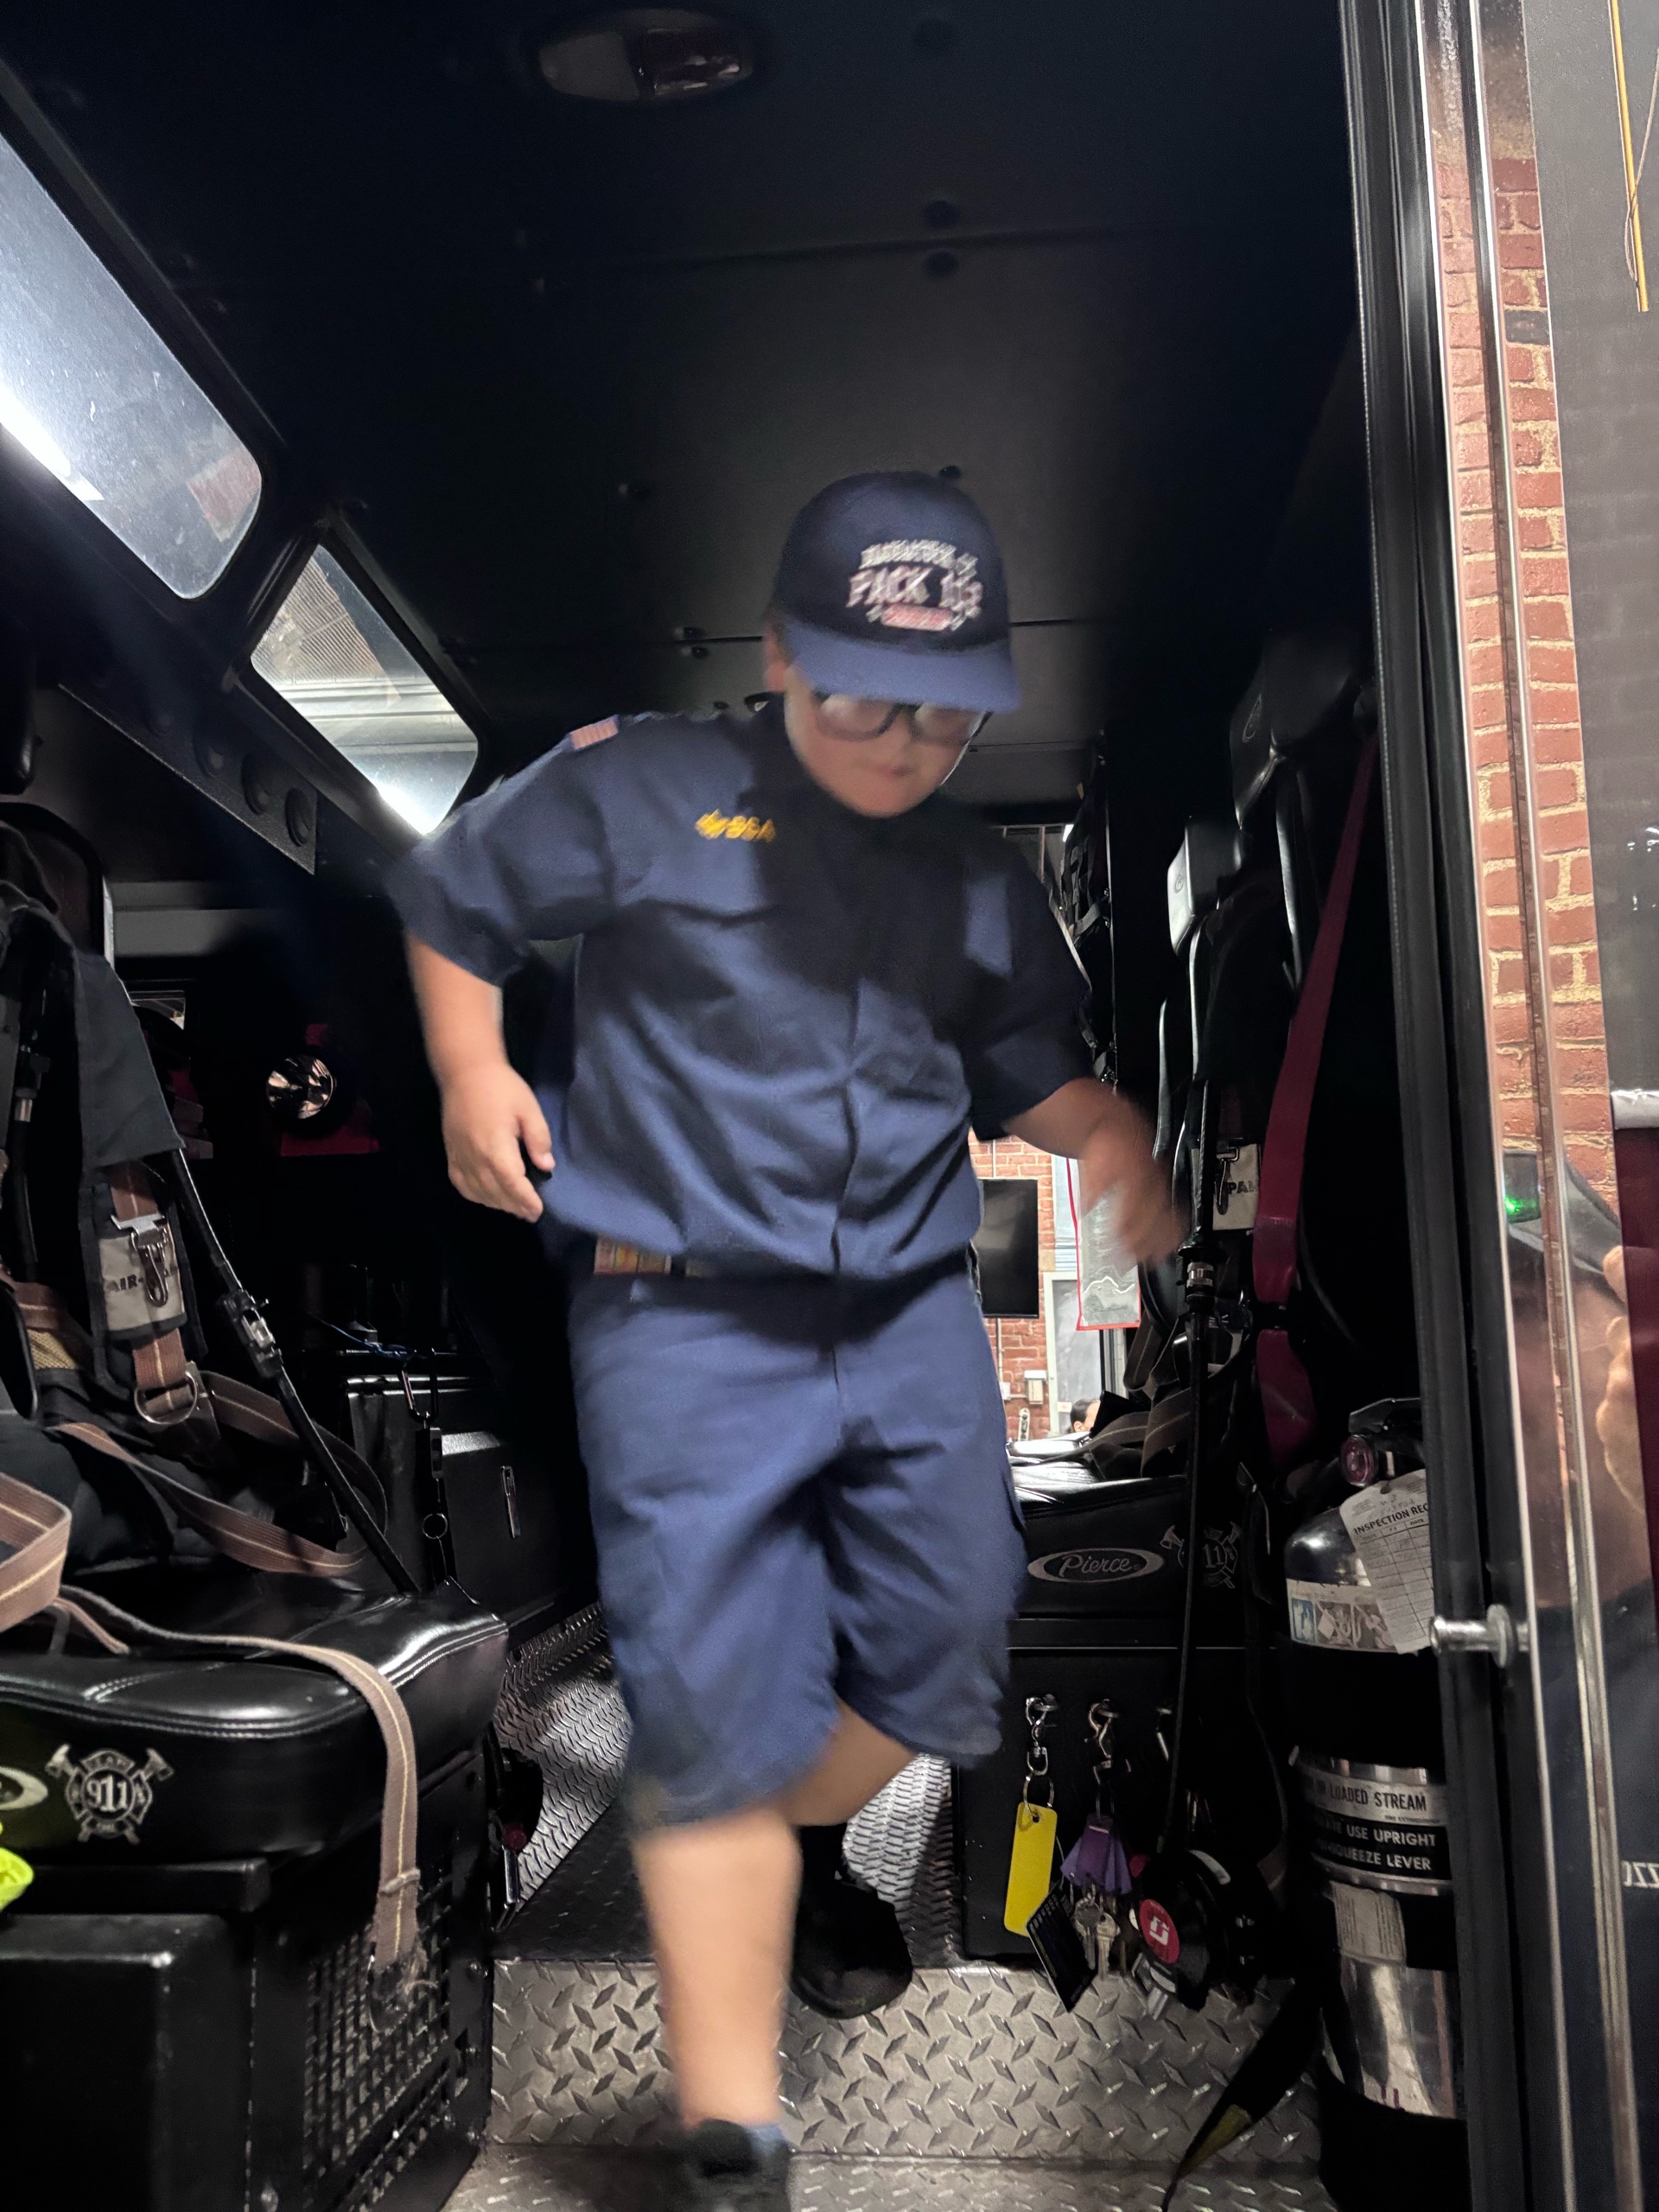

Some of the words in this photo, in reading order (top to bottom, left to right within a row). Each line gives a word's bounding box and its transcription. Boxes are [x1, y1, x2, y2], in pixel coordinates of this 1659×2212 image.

[1354, 1510, 1410, 1535] INSPECTION
[1058, 1554, 1132, 1578] Pierce
[1198, 1543, 1224, 1568] 11
[86, 1774, 129, 1812] 911
[1375, 1792, 1427, 1811] STREAM
[1346, 1824, 1369, 1840] USE
[1373, 1829, 1436, 1847] UPRIGHT
[1386, 1853, 1432, 1871] LEVER
